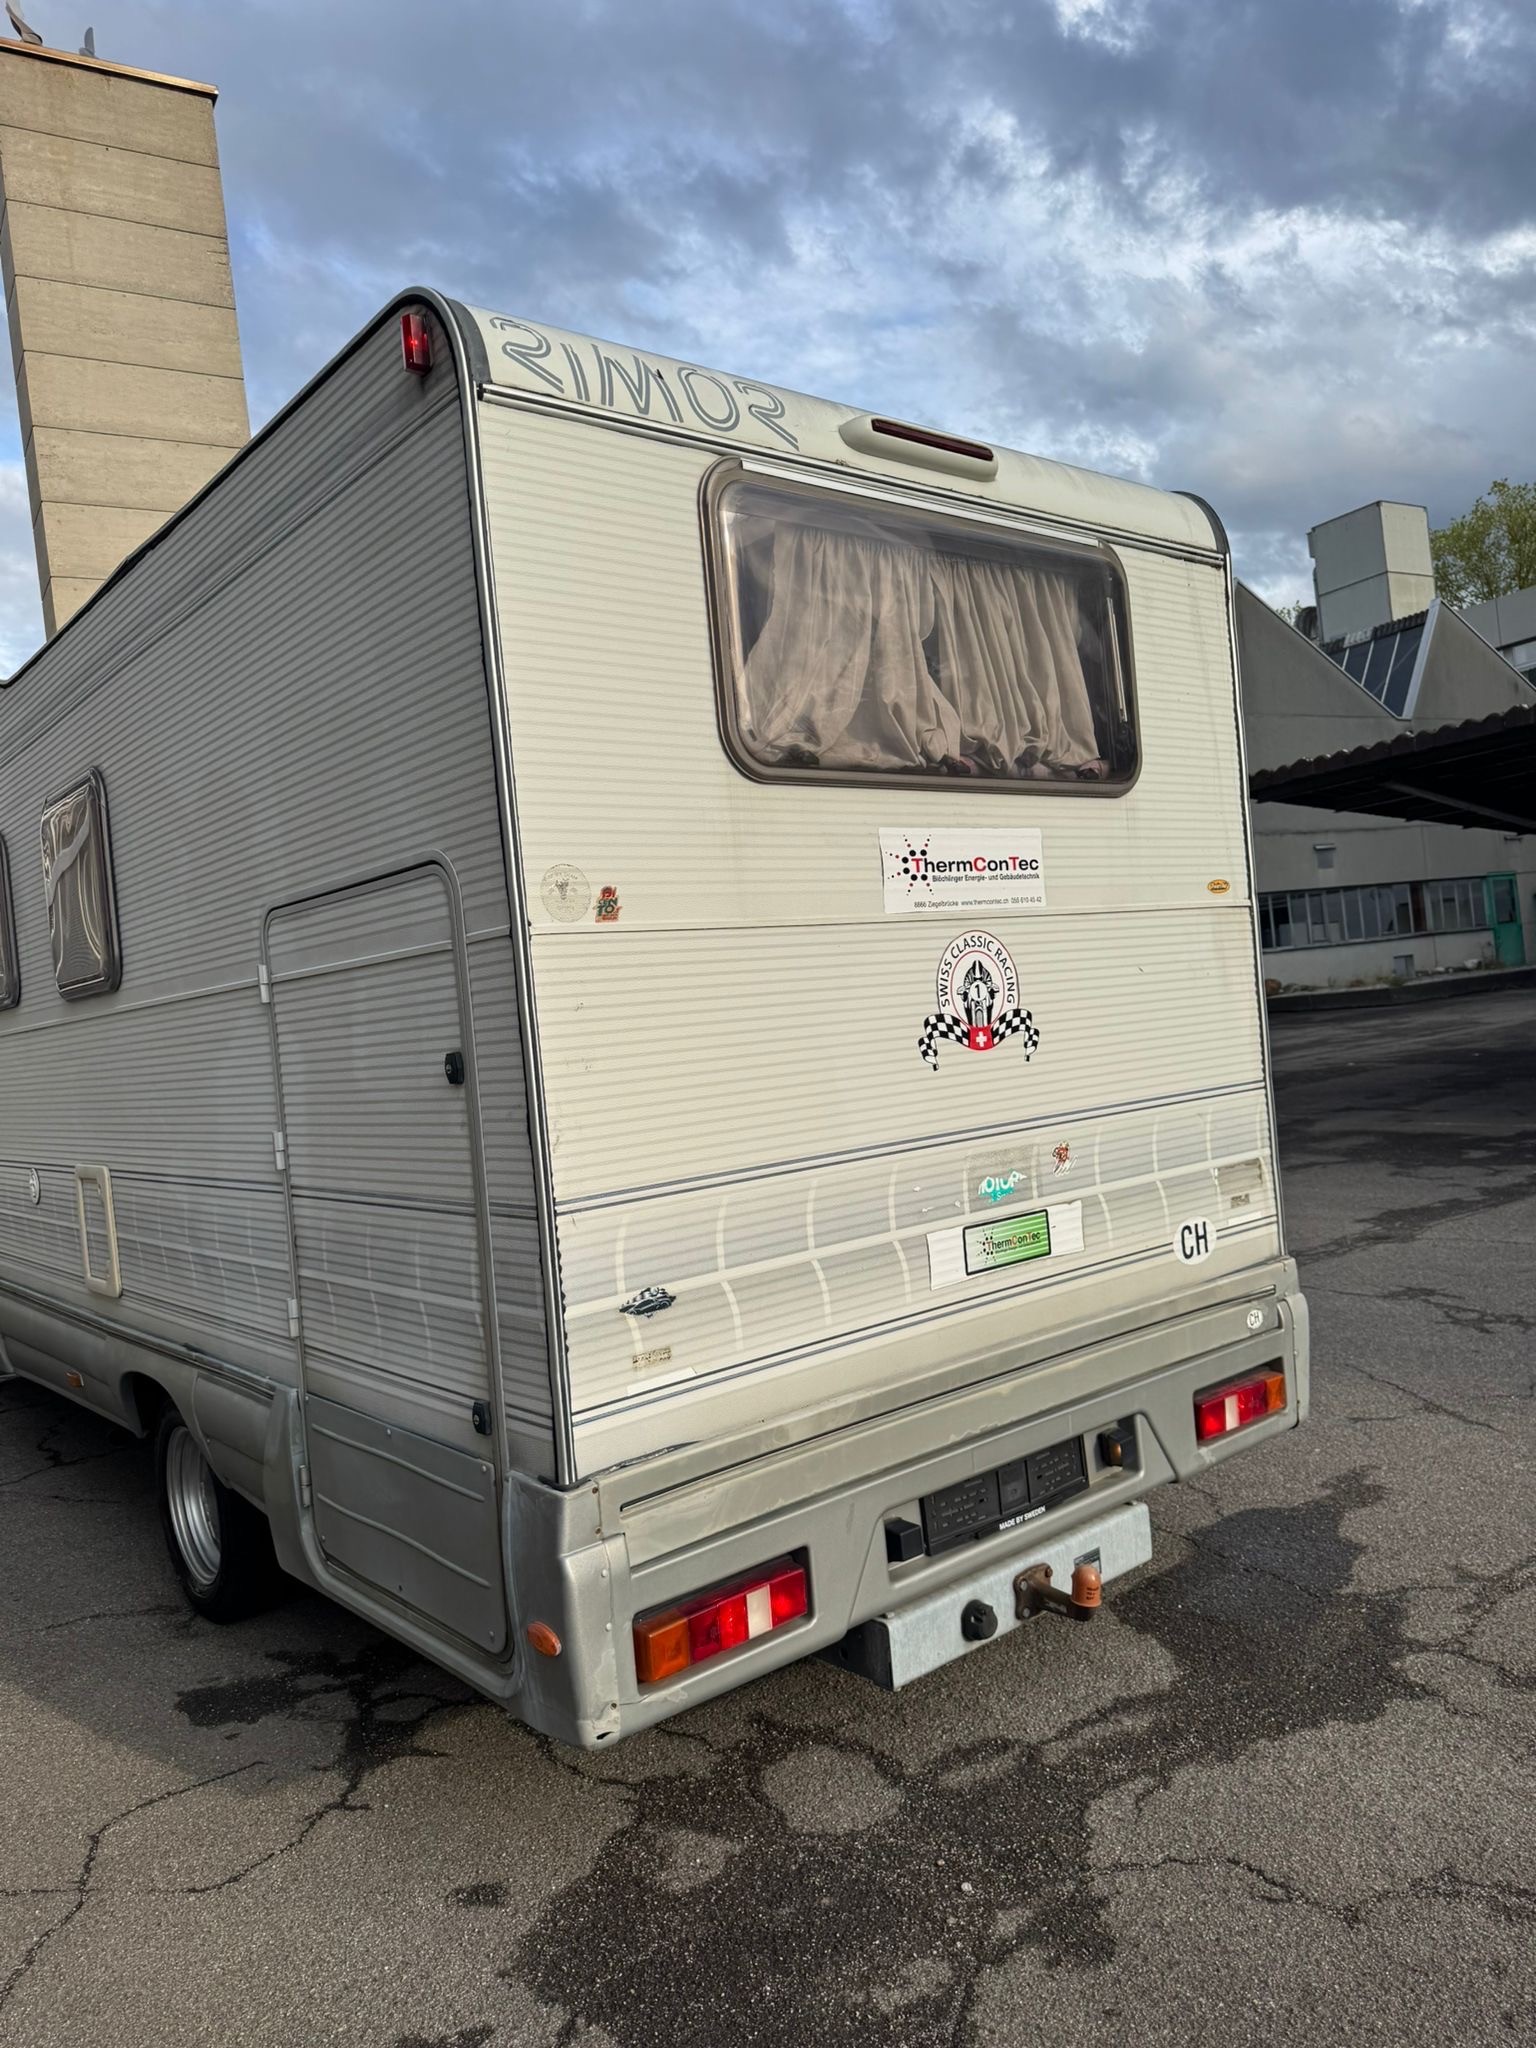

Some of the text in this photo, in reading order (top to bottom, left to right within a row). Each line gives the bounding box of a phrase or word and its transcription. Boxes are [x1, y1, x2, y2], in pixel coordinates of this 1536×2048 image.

[490, 316, 799, 451] RIMOR
[911, 856, 1039, 873] ThermConTec
[939, 935, 1015, 1008] SWISS CLASSIC RACING
[974, 984, 981, 999] 1
[986, 1231, 1041, 1251] ThermConTec
[1181, 1221, 1209, 1259] CH
[1249, 1312, 1260, 1326] CH
[999, 1505, 1046, 1530] MADE BY SWEDEN
